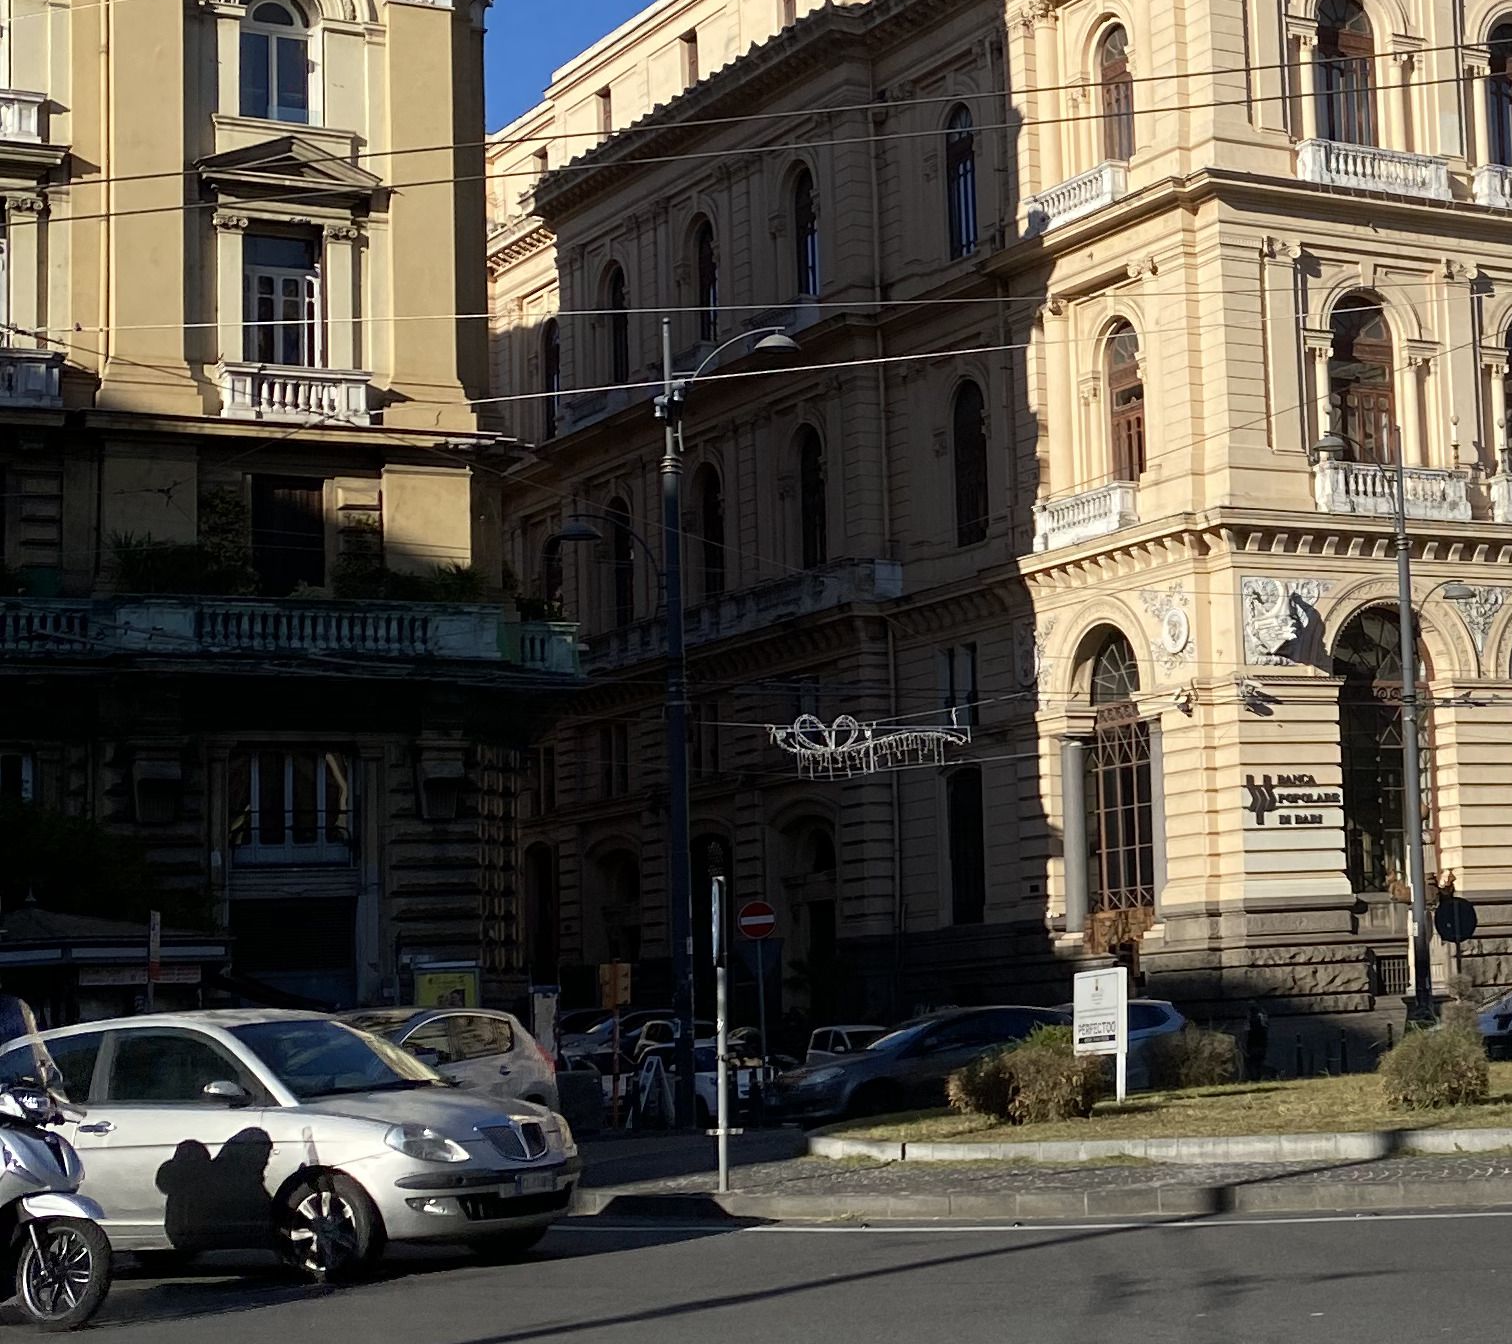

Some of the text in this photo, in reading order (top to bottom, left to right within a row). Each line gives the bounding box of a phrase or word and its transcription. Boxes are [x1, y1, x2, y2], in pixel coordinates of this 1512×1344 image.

[1276, 773, 1318, 786] BANCA
[1277, 792, 1341, 804] POPOLARE
[1278, 813, 1323, 825] DI BARI
